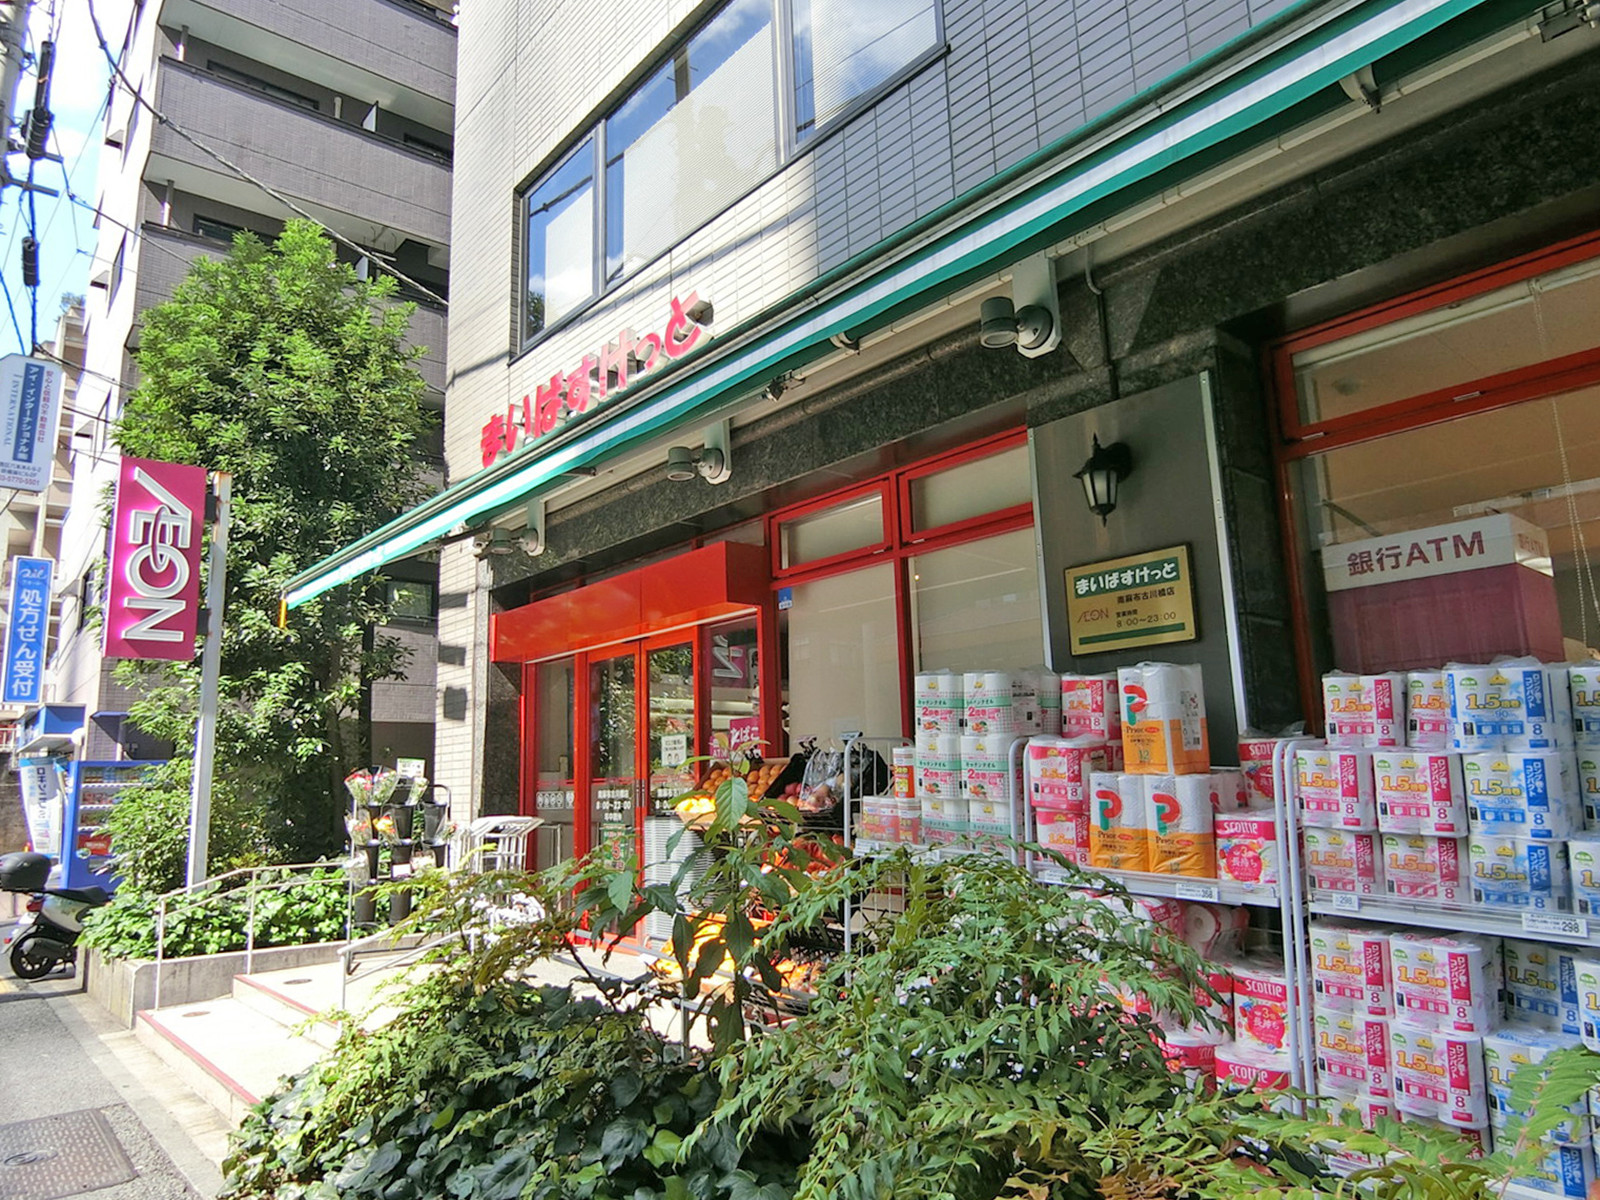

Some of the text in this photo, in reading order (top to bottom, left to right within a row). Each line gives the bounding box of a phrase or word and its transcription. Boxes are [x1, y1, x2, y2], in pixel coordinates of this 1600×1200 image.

[1347, 531, 1486, 577] 銀行ATM
[1075, 563, 1177, 595] まいばすけっと
[1116, 586, 1175, 604] 南麻布古川橋店
[12, 589, 42, 697] 処方せん受付
[1532, 724, 1543, 735] 8
[1071, 787, 1078, 797] 8
[1345, 803, 1354, 814] 8
[1438, 808, 1447, 819] 8
[1533, 814, 1545, 825] 8
[1080, 853, 1087, 862] 8
[1362, 883, 1371, 893] 8
[1445, 888, 1454, 899] 8
[1561, 921, 1580, 933] 298
[1371, 992, 1380, 1003] 8
[1457, 1007, 1467, 1018] 8
[1566, 1010, 1576, 1021] 8
[1372, 1073, 1382, 1084] 8
[1455, 1096, 1465, 1108] 8
